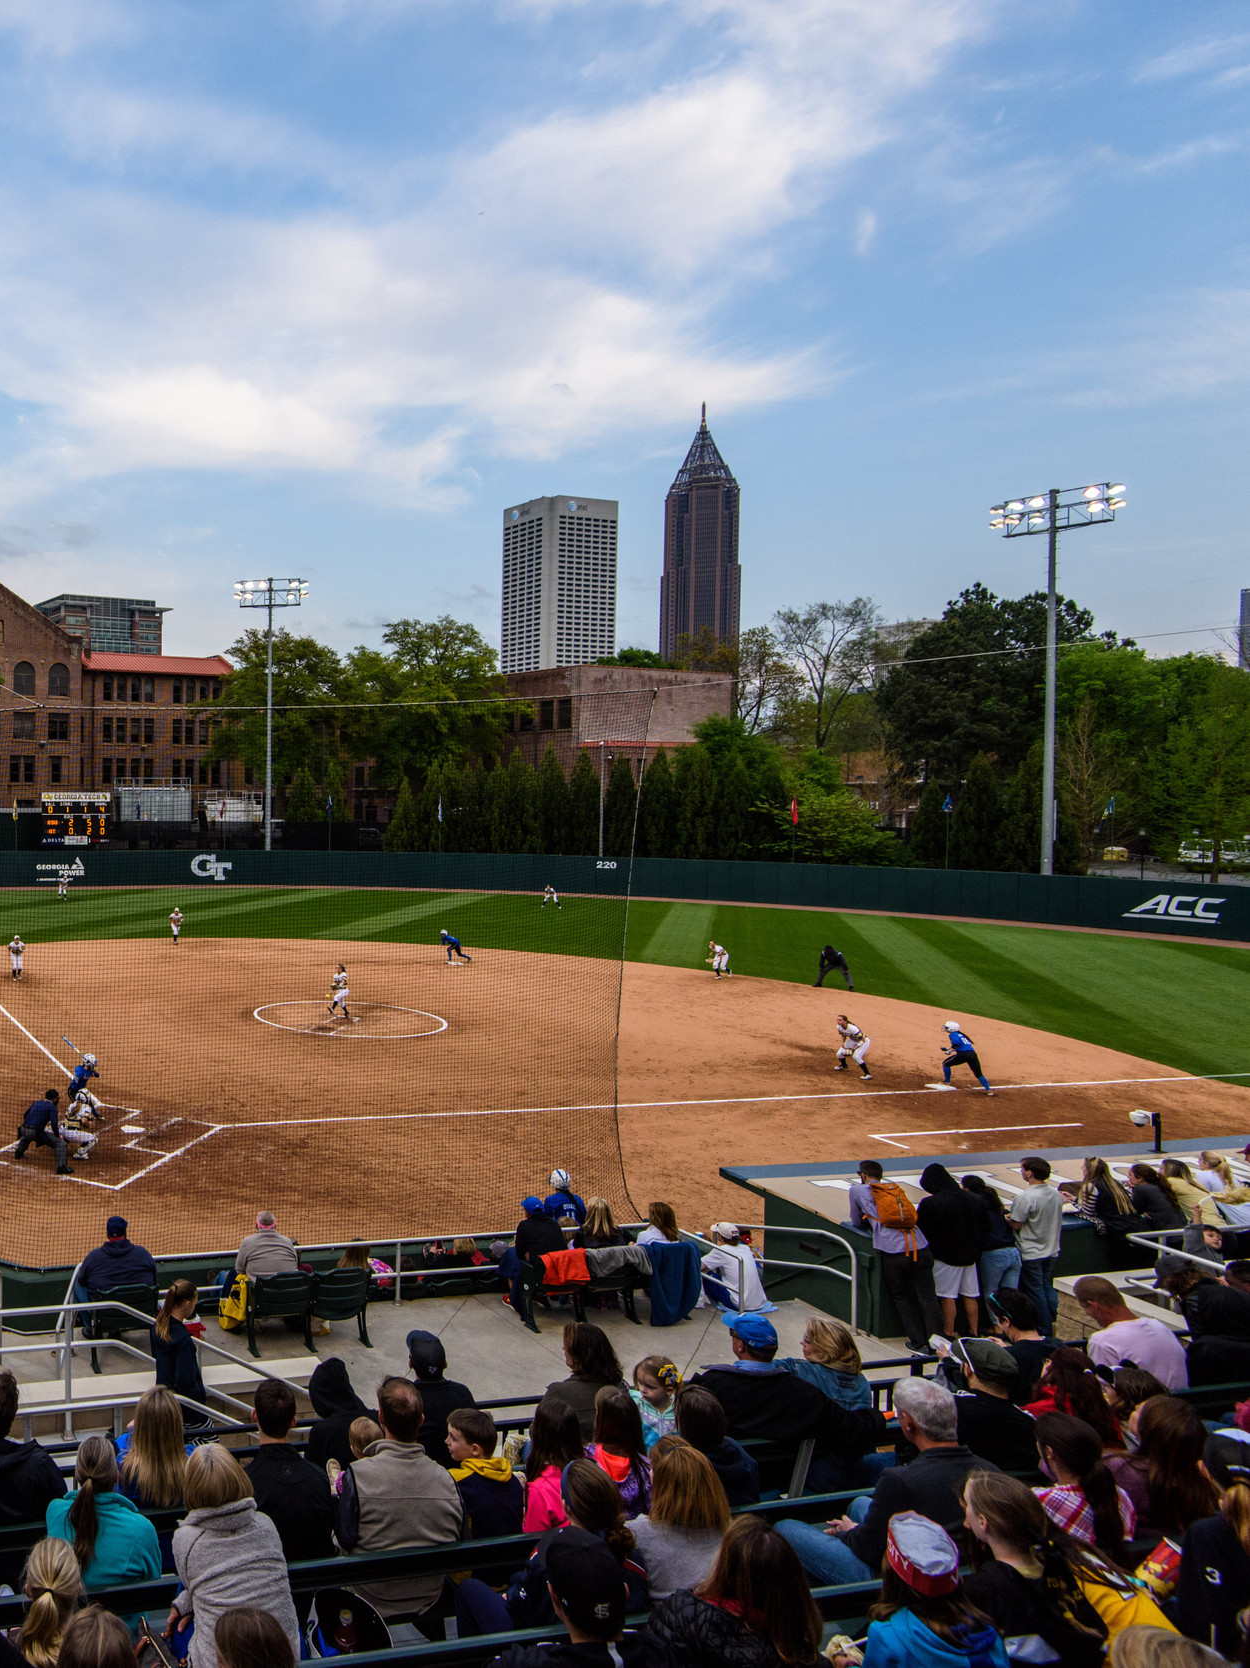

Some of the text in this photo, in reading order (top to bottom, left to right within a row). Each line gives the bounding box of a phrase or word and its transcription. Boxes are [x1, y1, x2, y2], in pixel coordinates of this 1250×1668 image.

[68, 827, 74, 835] 0
[86, 827, 92, 835] 2
[99, 827, 105, 835] 0
[190, 853, 232, 880] GT
[596, 860, 618, 869] 220
[1129, 894, 1227, 918] ACC
